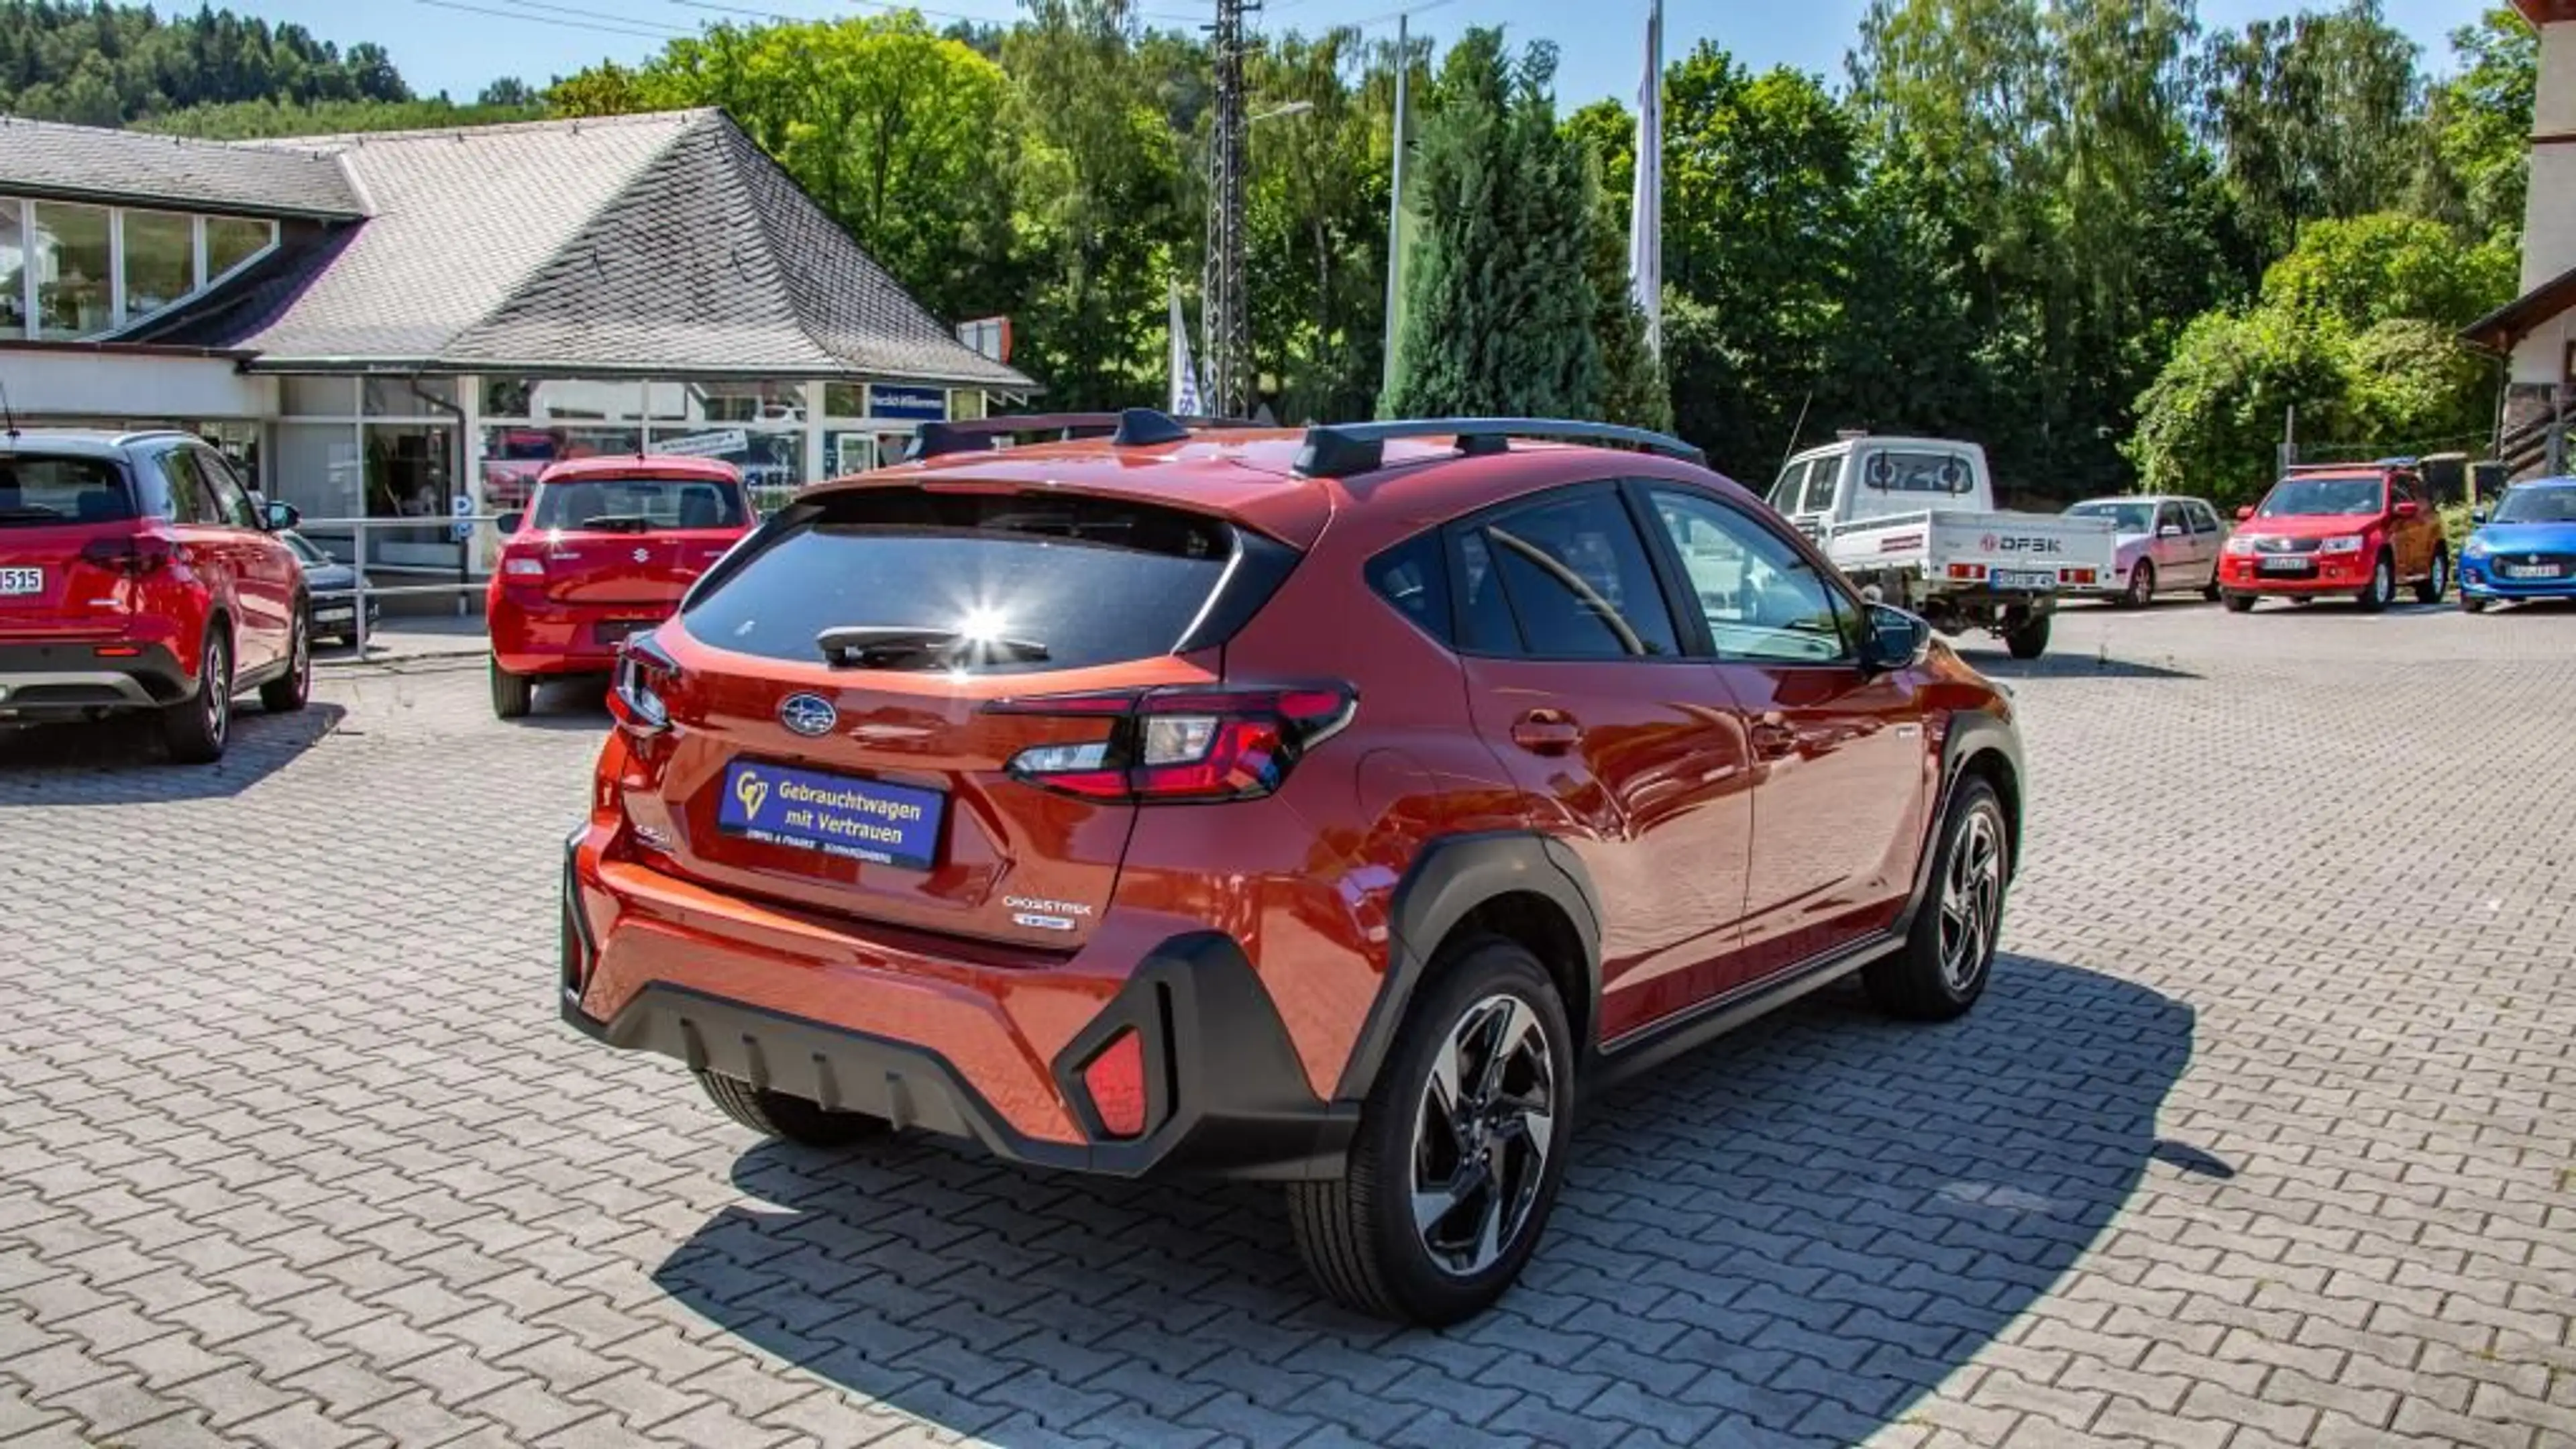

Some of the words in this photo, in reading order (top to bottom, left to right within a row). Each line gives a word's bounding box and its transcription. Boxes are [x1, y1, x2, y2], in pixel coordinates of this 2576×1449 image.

[780, 782, 922, 820] Gebrauchtwagen
[786, 810, 813, 827] mit
[818, 812, 903, 844] Vertrauen
